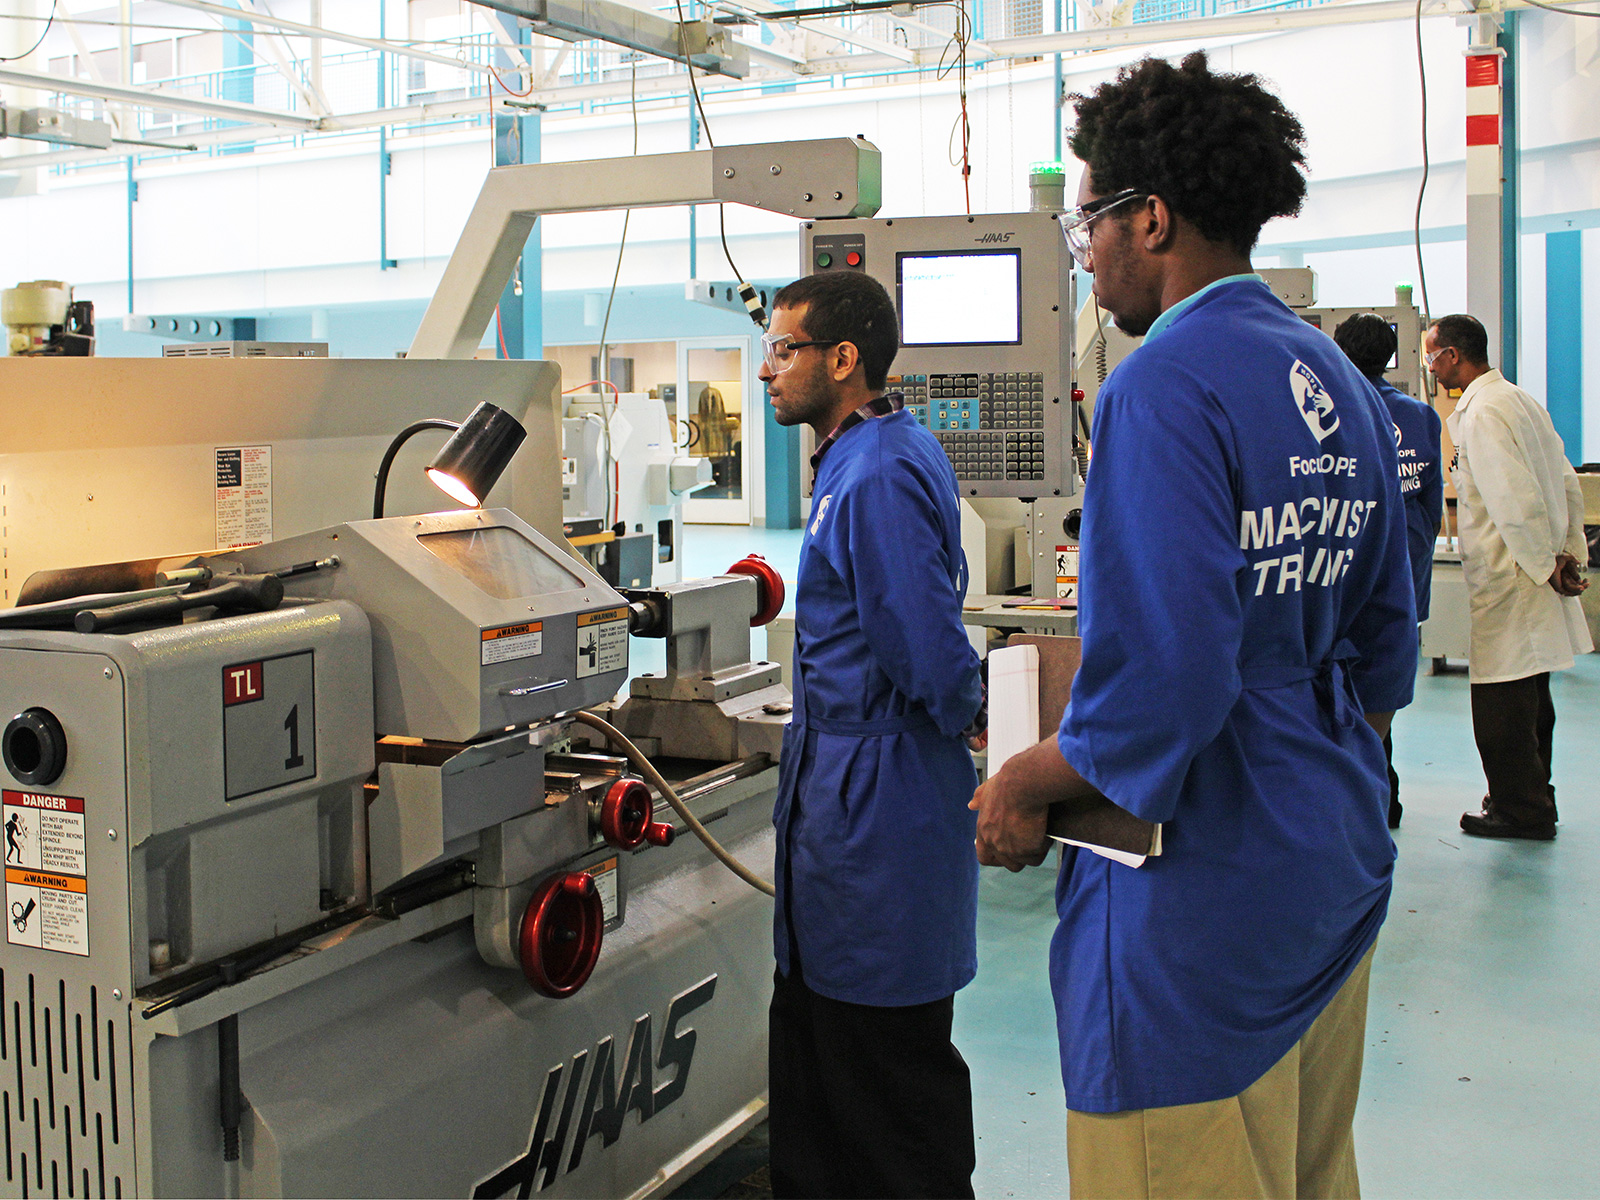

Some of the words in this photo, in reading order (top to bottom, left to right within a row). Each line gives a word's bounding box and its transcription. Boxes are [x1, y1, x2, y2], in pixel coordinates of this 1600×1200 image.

[974, 232, 1015, 243] HAAS
[1300, 368, 1318, 390] HOPE
[593, 611, 617, 620] WARNING
[502, 625, 530, 636] WARNING
[231, 669, 256, 698] TL
[284, 704, 304, 770] 1
[23, 794, 67, 810] DANGER
[30, 874, 68, 888] WARNING
[472, 973, 718, 1200] HAAS
